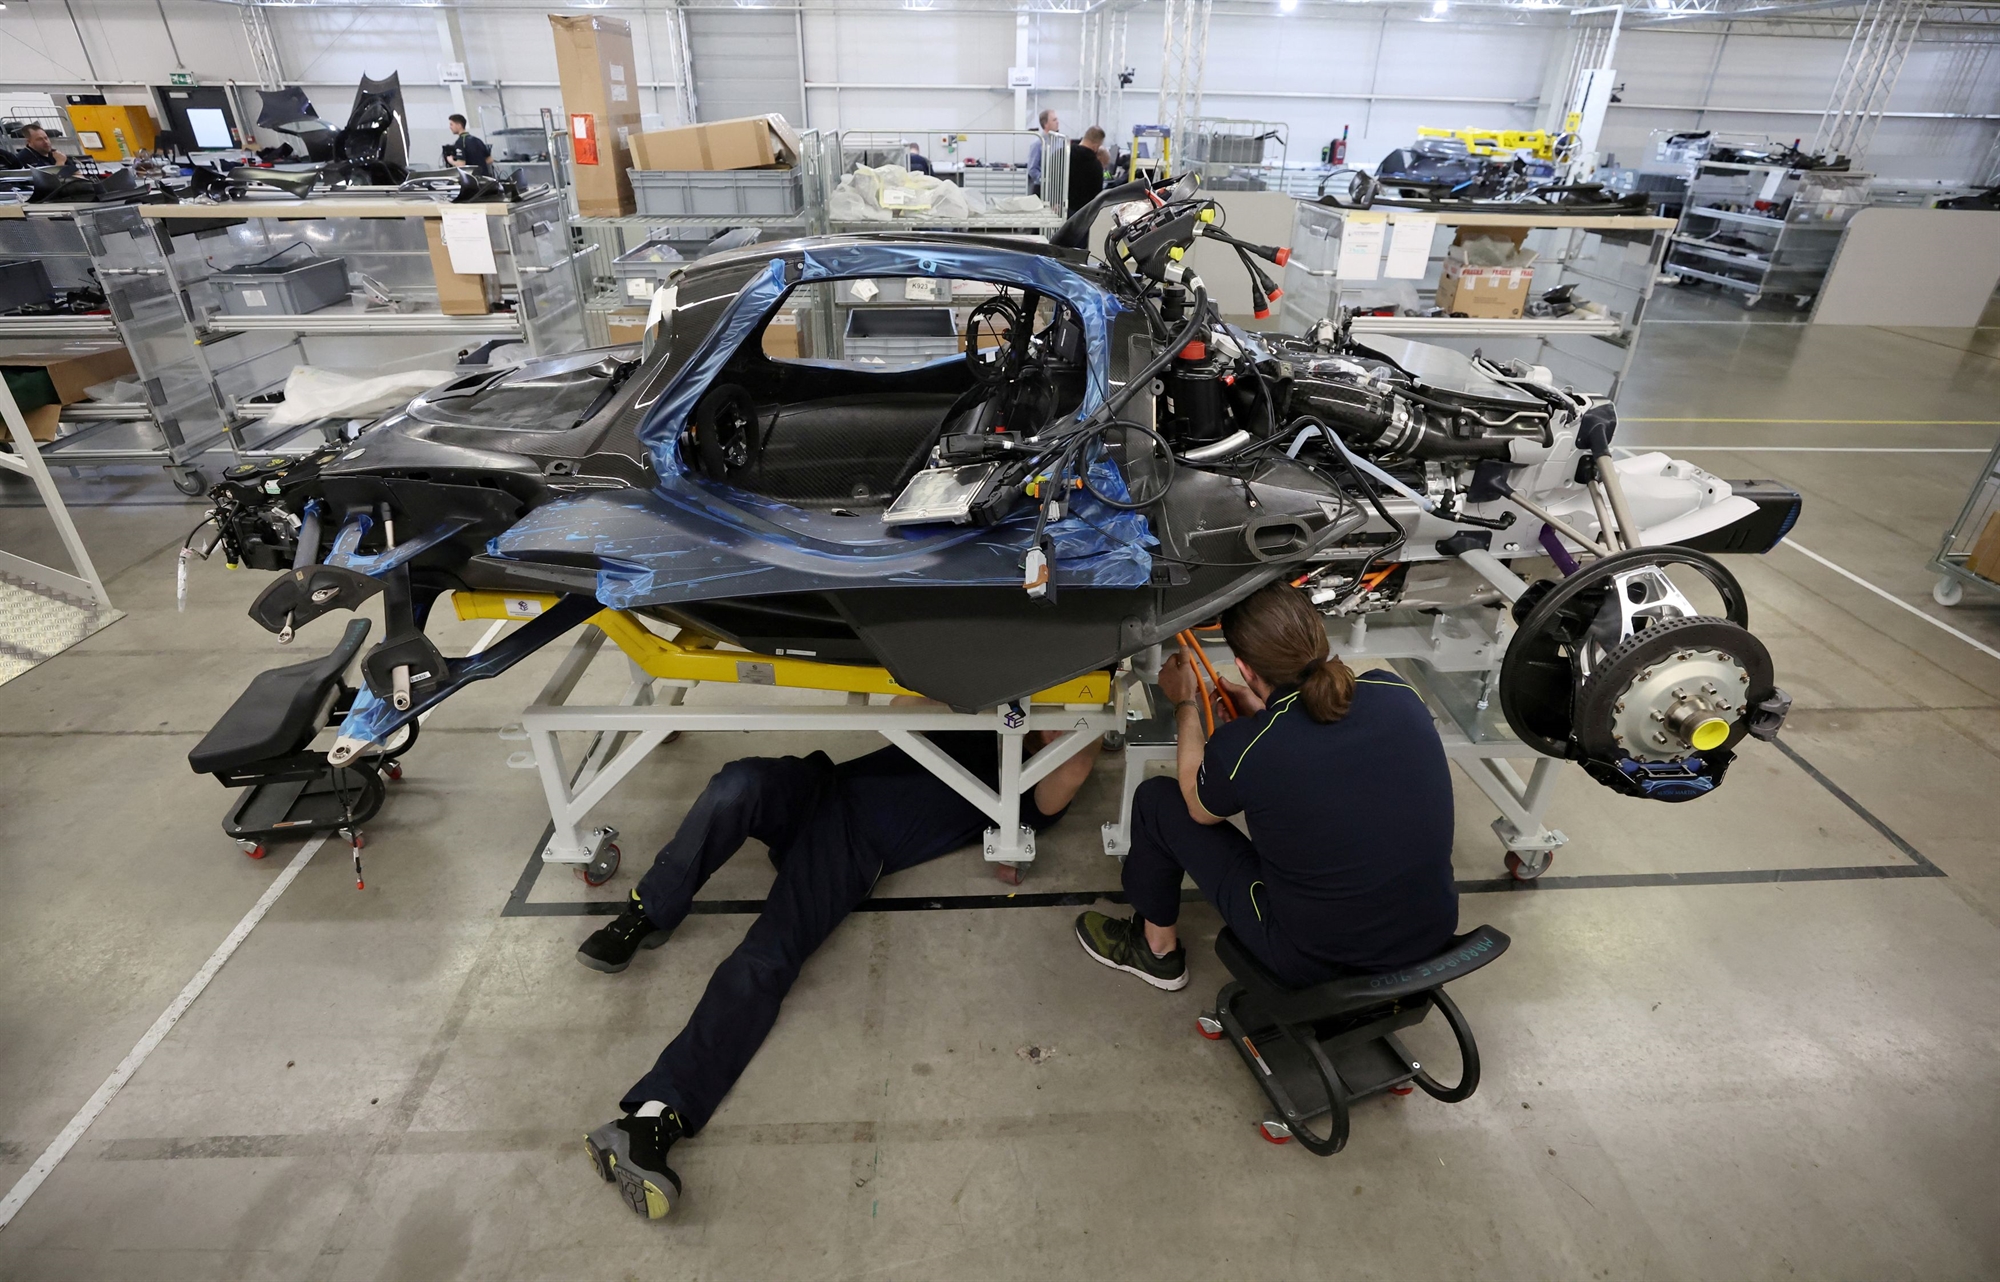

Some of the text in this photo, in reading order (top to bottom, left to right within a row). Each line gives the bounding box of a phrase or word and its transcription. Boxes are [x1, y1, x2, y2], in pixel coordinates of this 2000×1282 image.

[911, 282, 929, 290] K923
[1079, 685, 1094, 699] A
[1074, 717, 1090, 729] A
[1416, 936, 1494, 977] MARRIAGE
